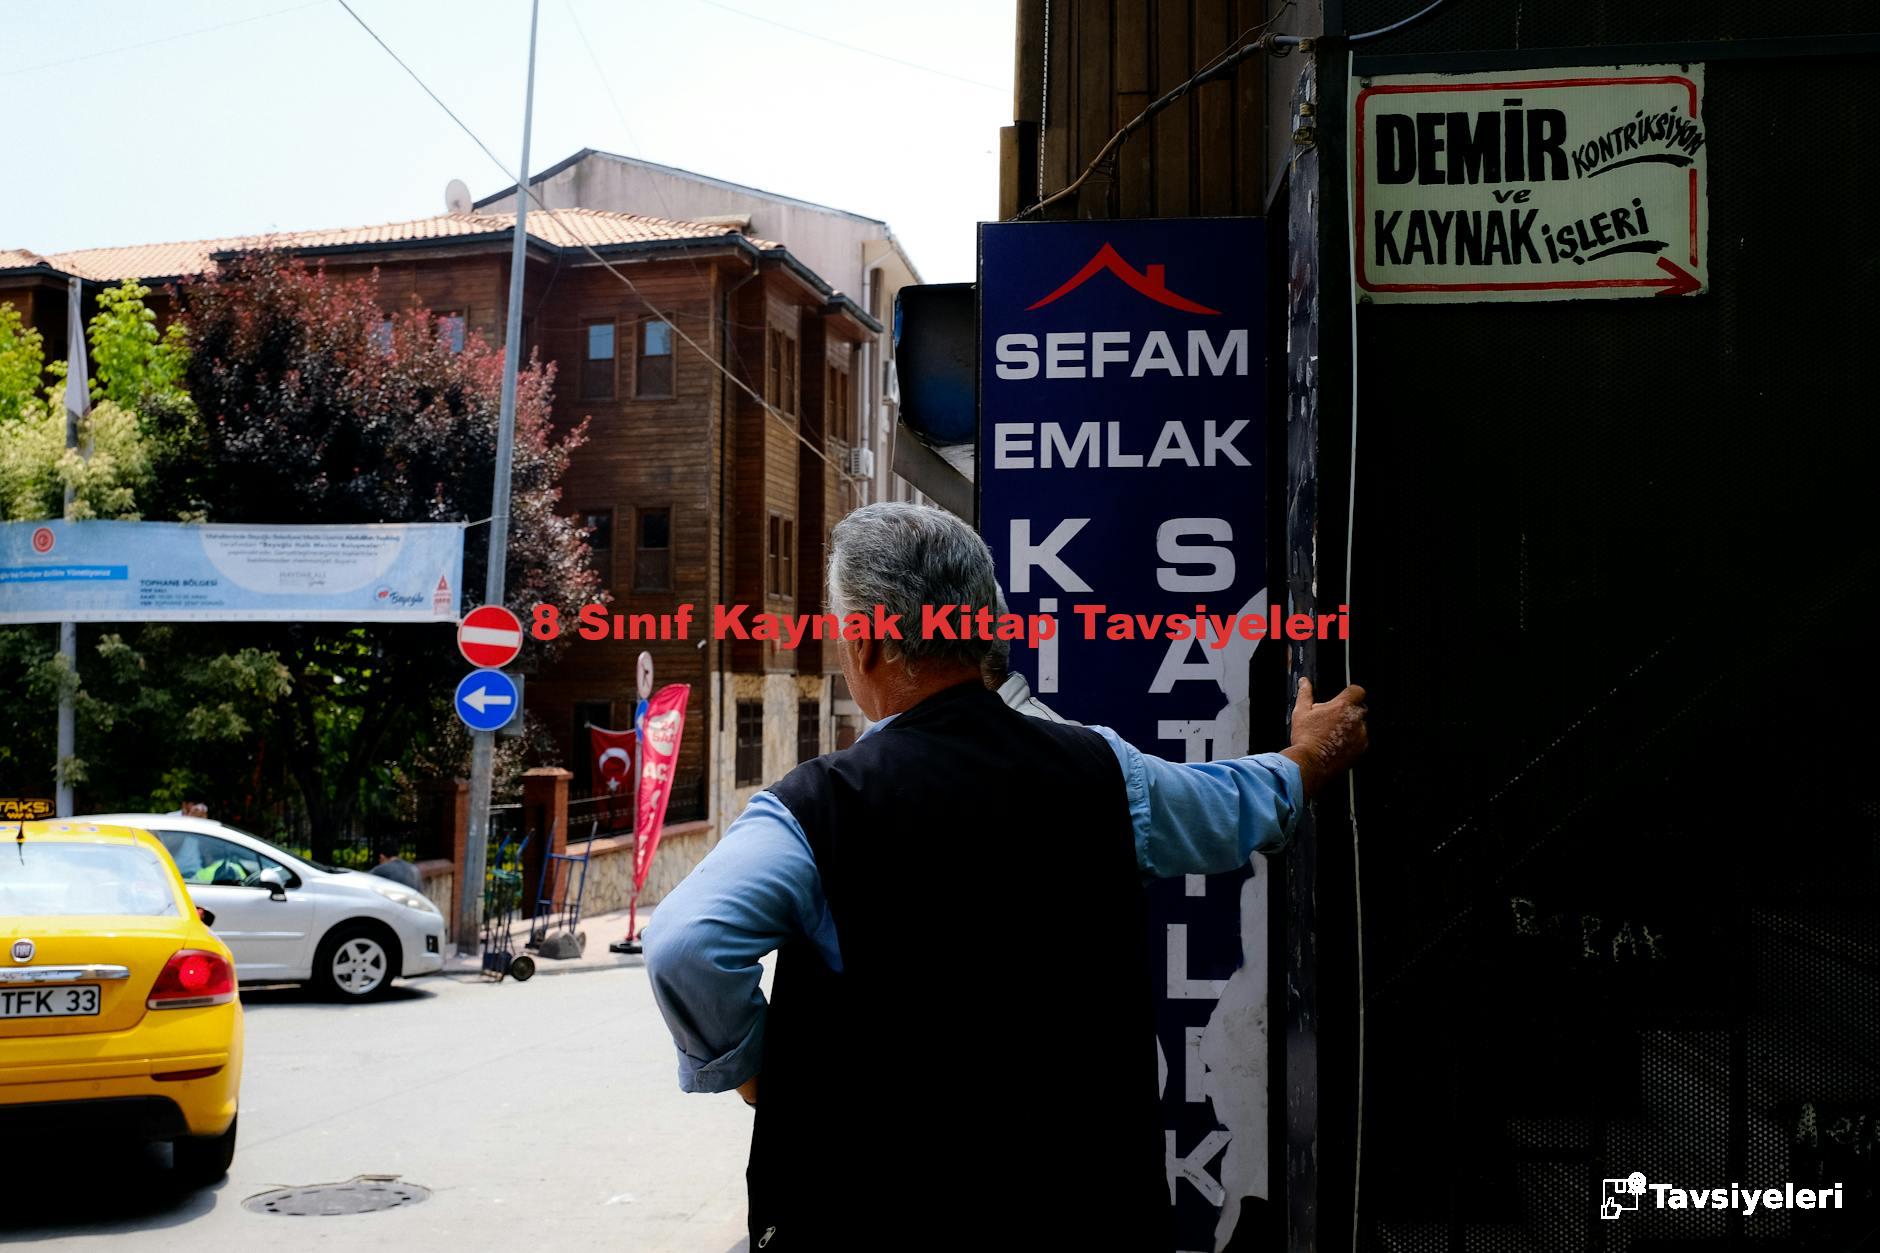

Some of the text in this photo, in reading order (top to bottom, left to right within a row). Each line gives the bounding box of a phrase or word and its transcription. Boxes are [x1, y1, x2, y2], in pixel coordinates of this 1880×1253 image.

[1376, 98, 1569, 185] DEMİR
[1492, 189, 1531, 204] ve
[1375, 208, 1542, 266] KAYNAK
[995, 329, 1248, 380] SEFAM
[994, 420, 1252, 469] EMLAK
[1, 989, 96, 1014] TFK 33
